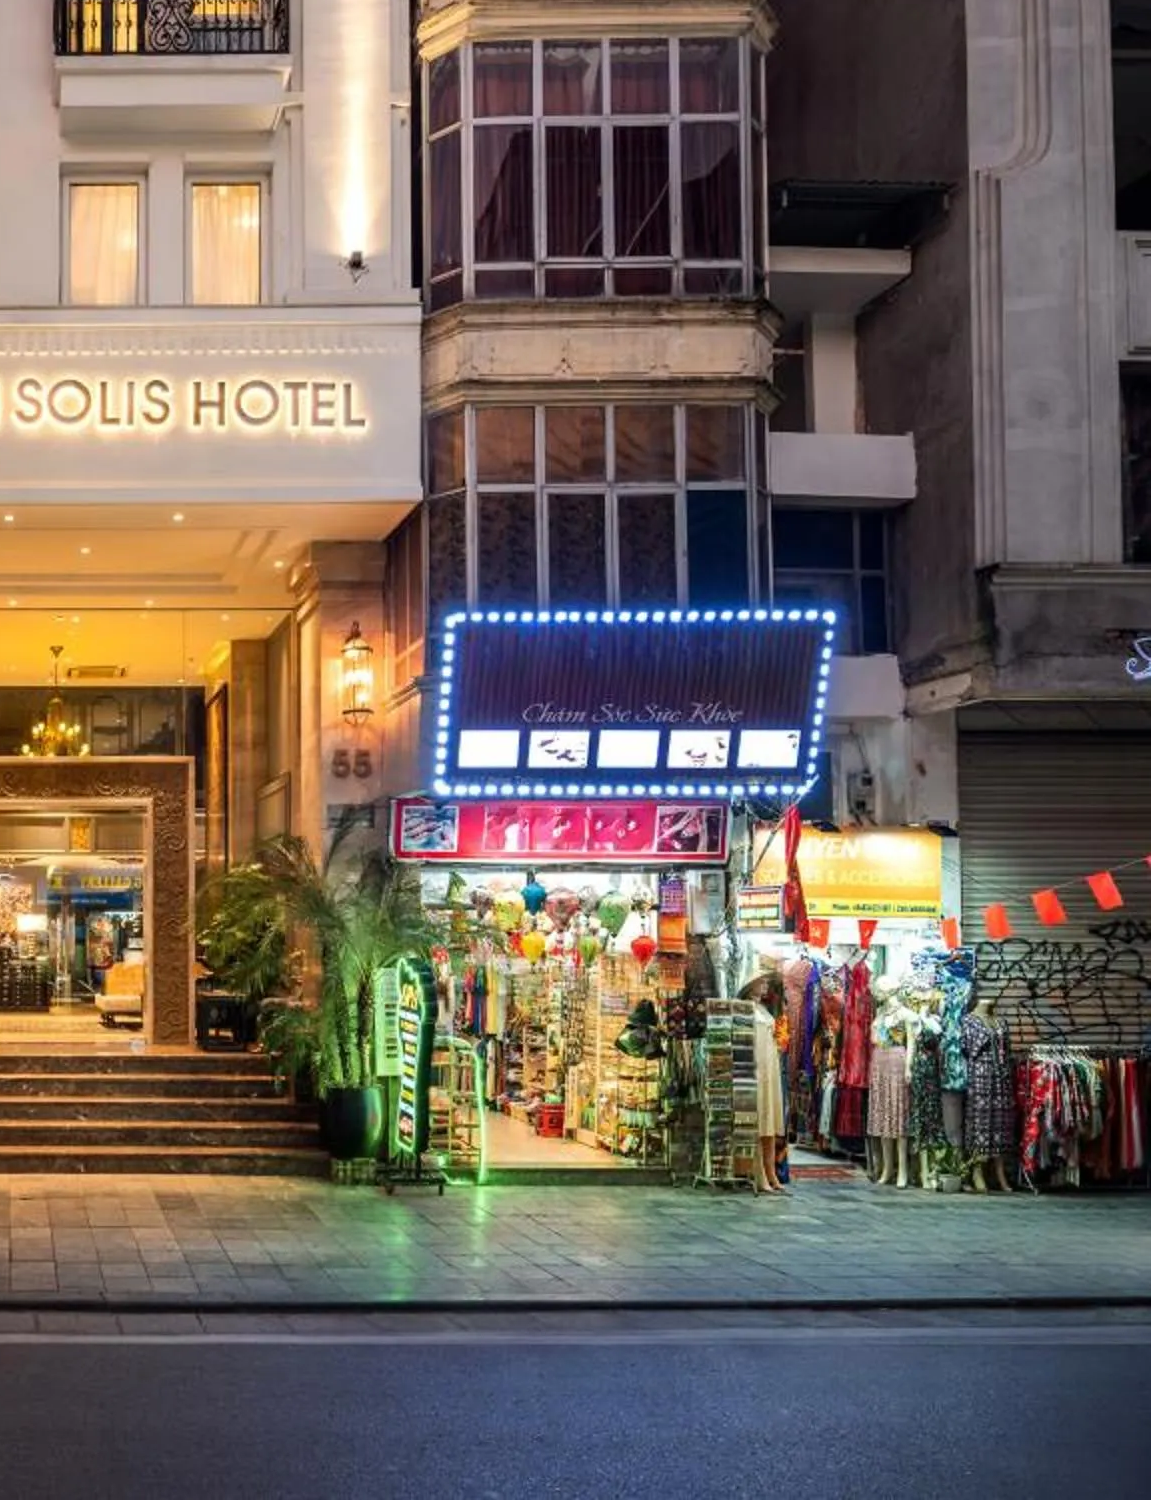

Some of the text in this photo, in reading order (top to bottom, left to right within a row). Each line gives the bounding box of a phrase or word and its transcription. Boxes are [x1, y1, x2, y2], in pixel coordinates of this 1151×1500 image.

[14, 379, 172, 426] SOLIS
[191, 381, 367, 428] HOTEL
[331, 749, 373, 779] 55
